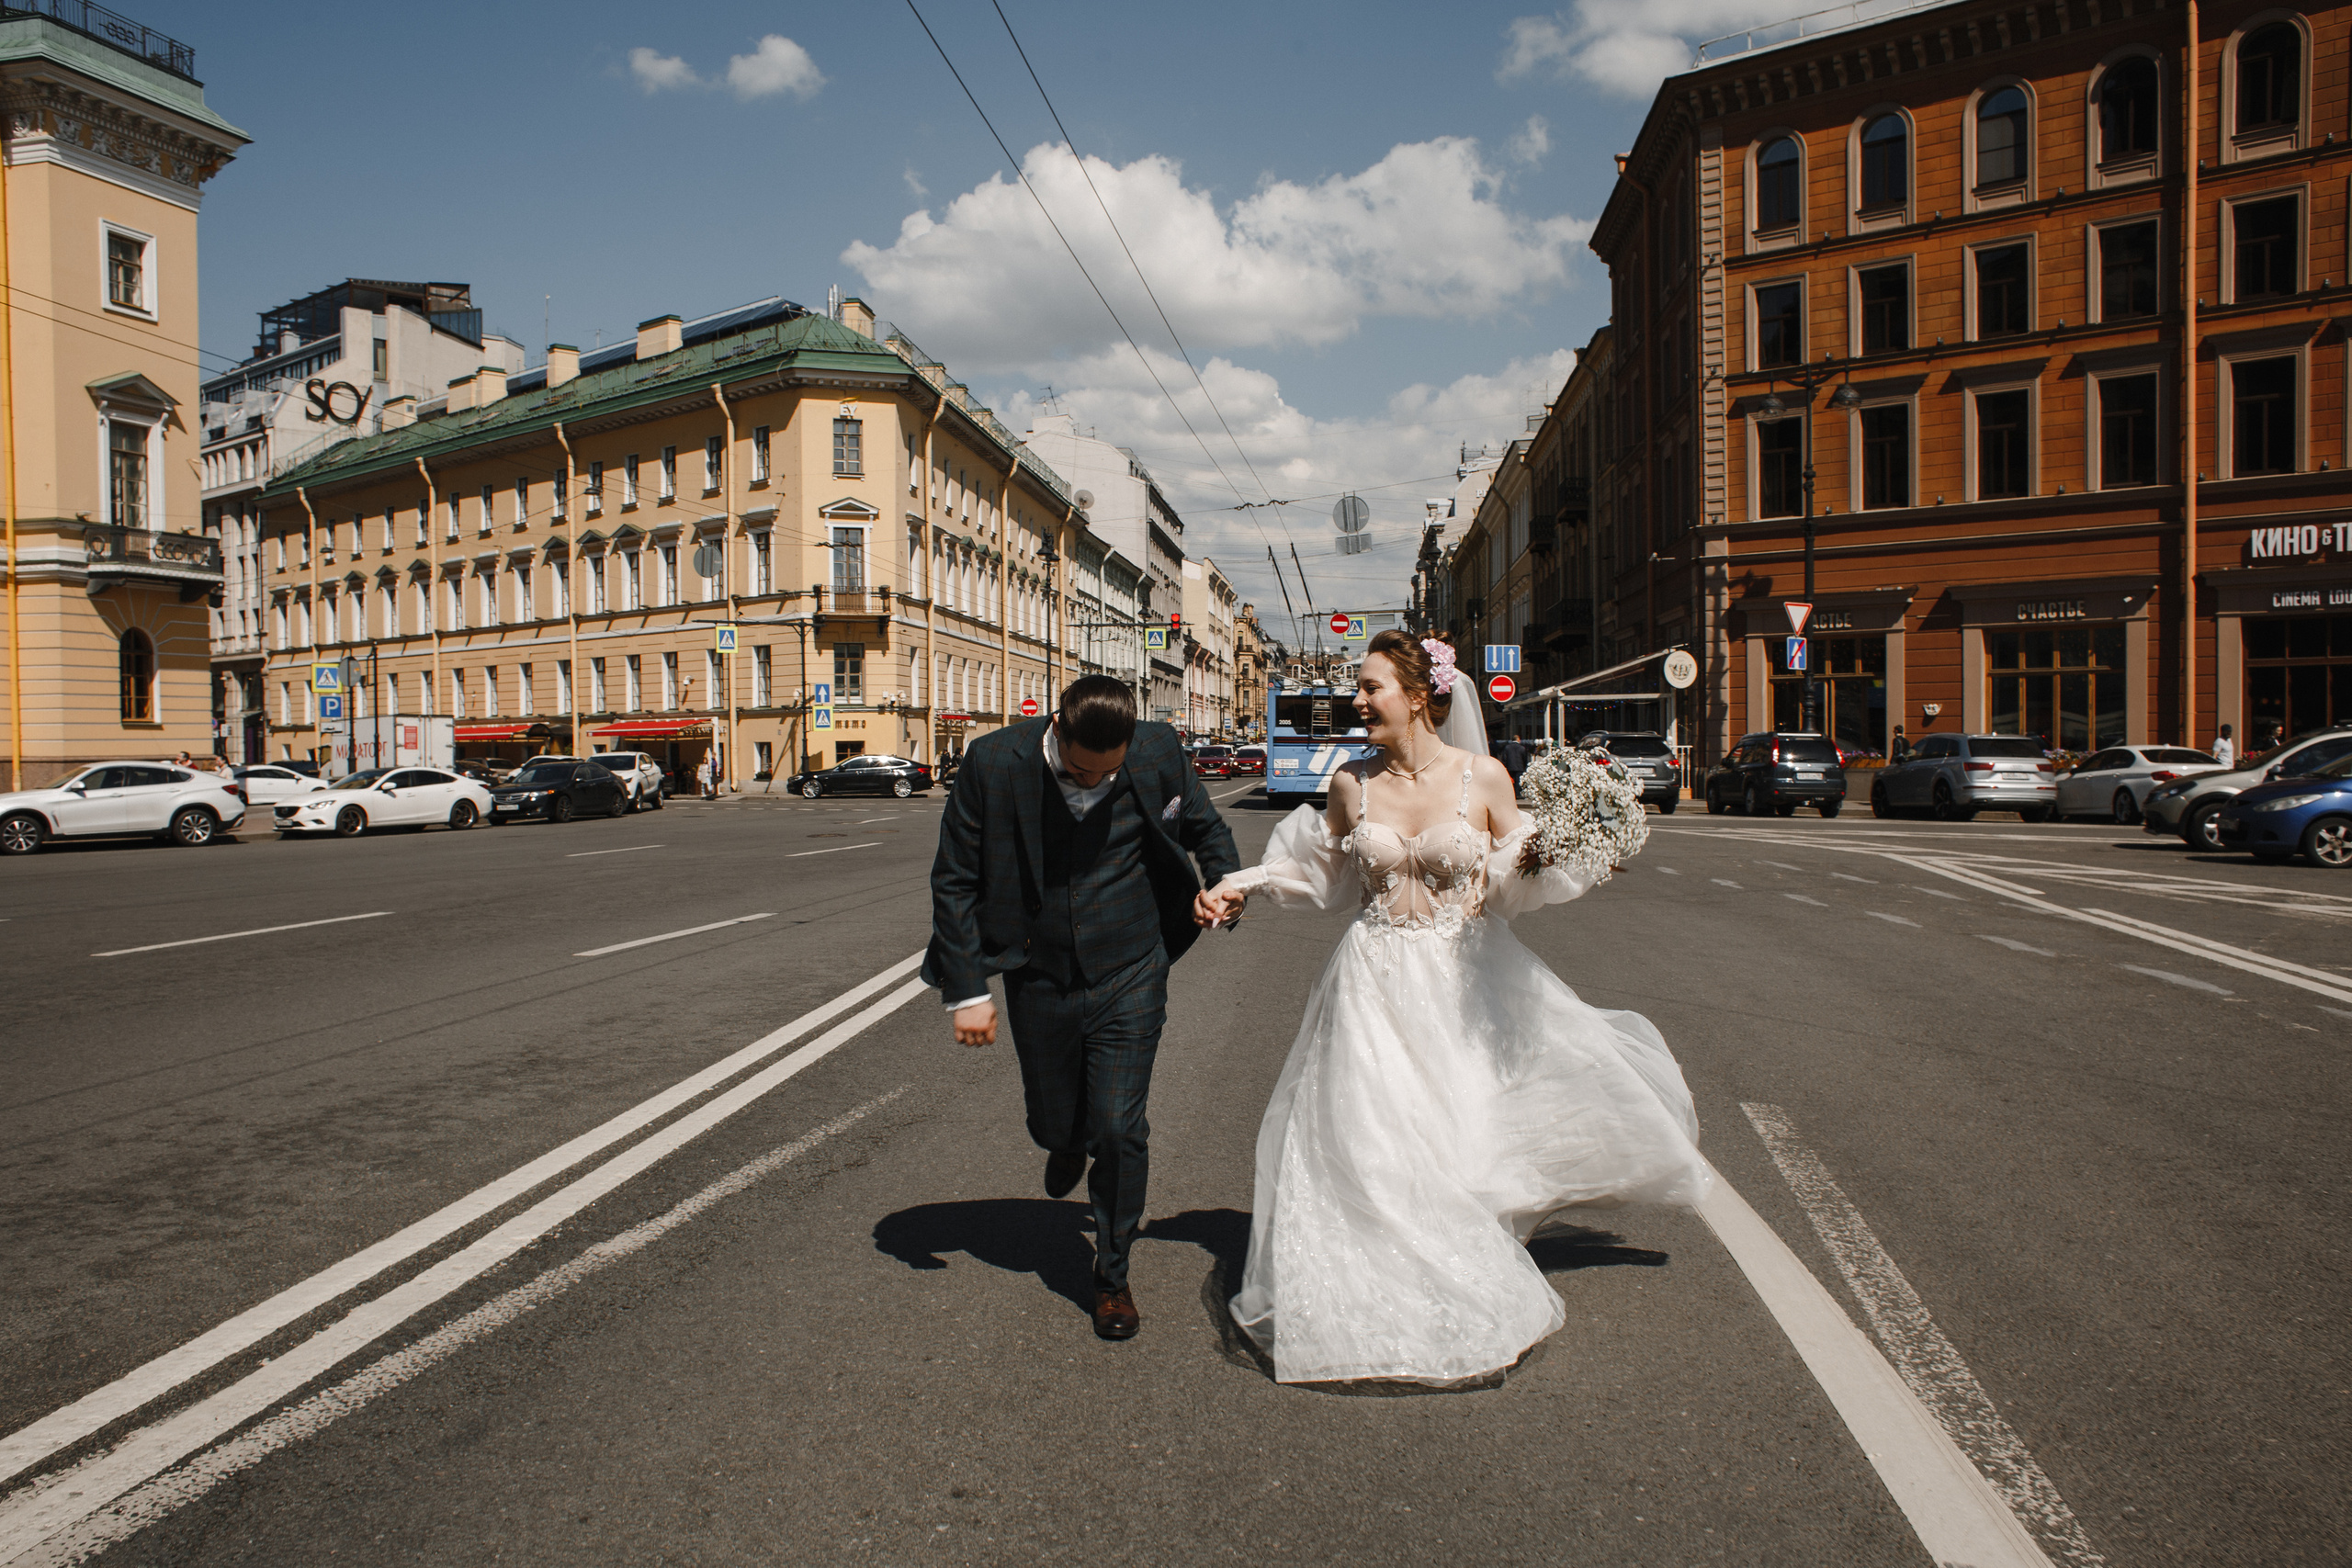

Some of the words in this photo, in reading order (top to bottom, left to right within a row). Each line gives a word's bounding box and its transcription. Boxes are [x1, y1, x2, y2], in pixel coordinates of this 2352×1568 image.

[2251, 525, 2319, 558] КИНО
[2272, 591, 2322, 608] CINEMA
[2018, 600, 2086, 620] СЧАСТЬЕ
